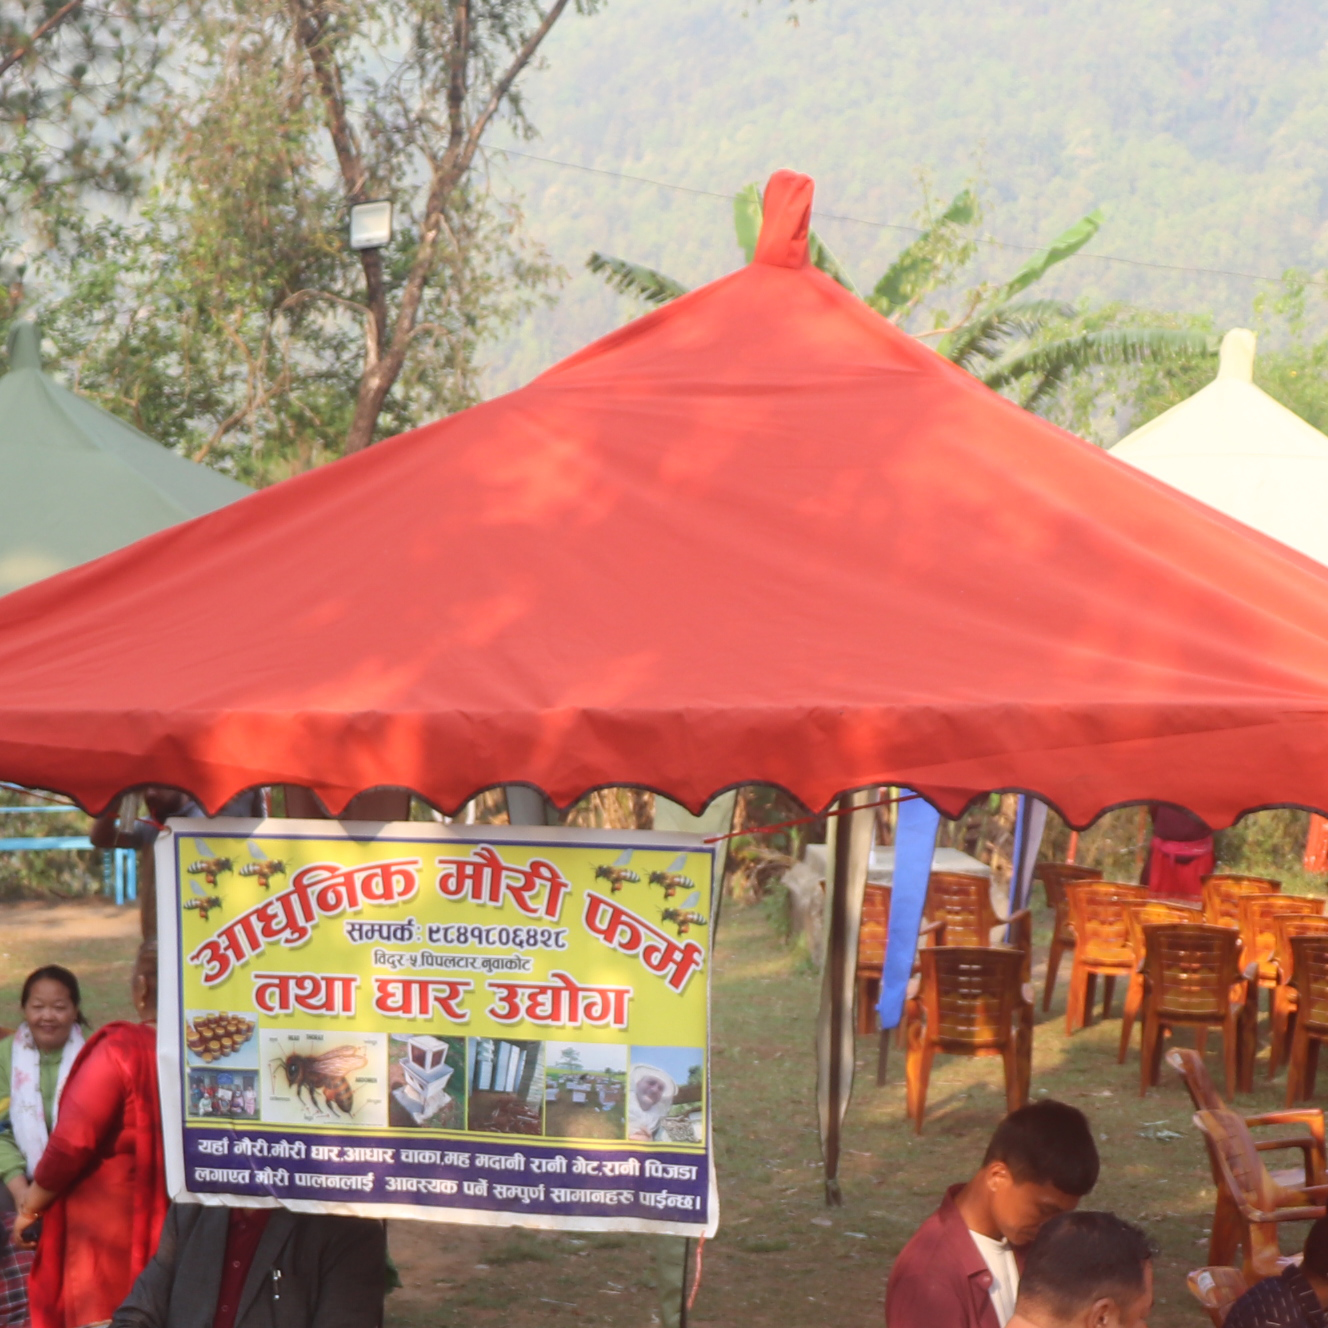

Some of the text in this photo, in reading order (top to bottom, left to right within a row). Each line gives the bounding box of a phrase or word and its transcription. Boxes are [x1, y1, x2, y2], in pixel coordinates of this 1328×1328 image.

[188, 845, 703, 990] आधुनिक मौरी फर्म
[427, 924, 568, 950] ९८४१८०६४२८
[254, 972, 631, 1027] तथा घार उद्योग
[194, 1166, 252, 1185] लगाएत
[254, 1165, 290, 1186] मौरी
[475, 1152, 526, 1171] मदानी
[530, 1156, 568, 1174] रानी
